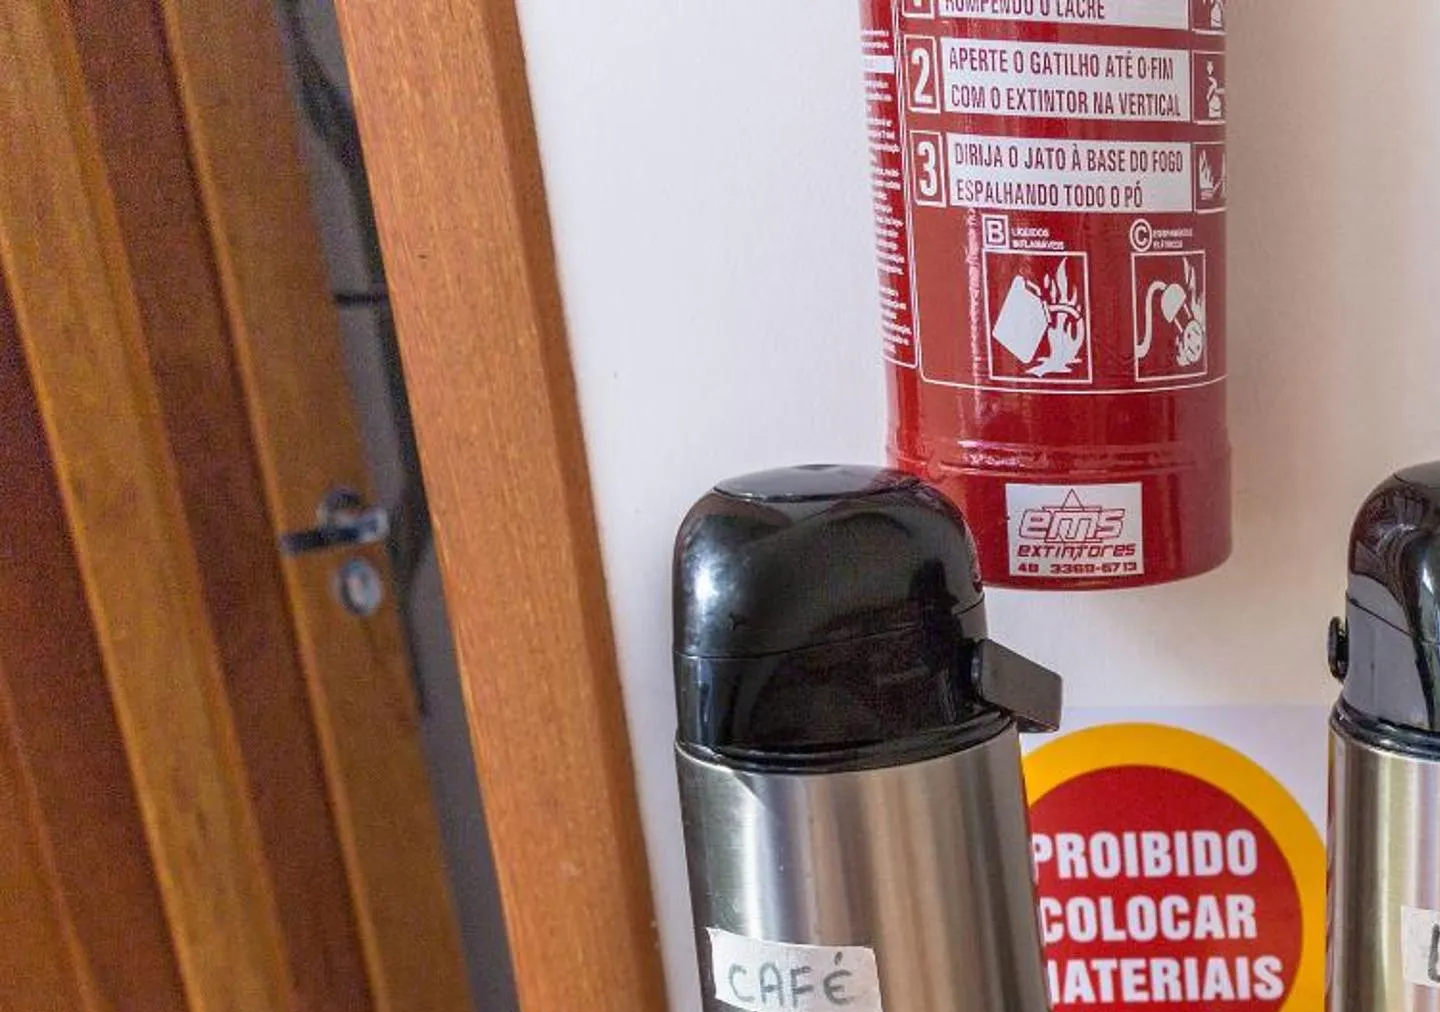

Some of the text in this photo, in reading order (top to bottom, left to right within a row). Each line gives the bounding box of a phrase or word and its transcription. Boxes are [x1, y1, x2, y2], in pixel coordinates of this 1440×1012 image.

[1056, 0, 1106, 20] LACRE
[911, 47, 933, 105] 2
[948, 46, 1175, 81] APERTE O GATILHO ATÉ O FIM
[951, 84, 1181, 118] COM O EXTINTOR NA VERTICAL
[917, 141, 938, 197] 3
[954, 141, 1184, 173] DIRIJA O JATO À BASE DO FOGO
[957, 179, 1143, 208] ESPALHANDO TODO O PÓ
[1017, 562, 1039, 574] 48
[1031, 828, 1259, 883] PROIBIDO
[1039, 893, 1258, 947] COLOCAR
[728, 951, 855, 1009] CAFÉ
